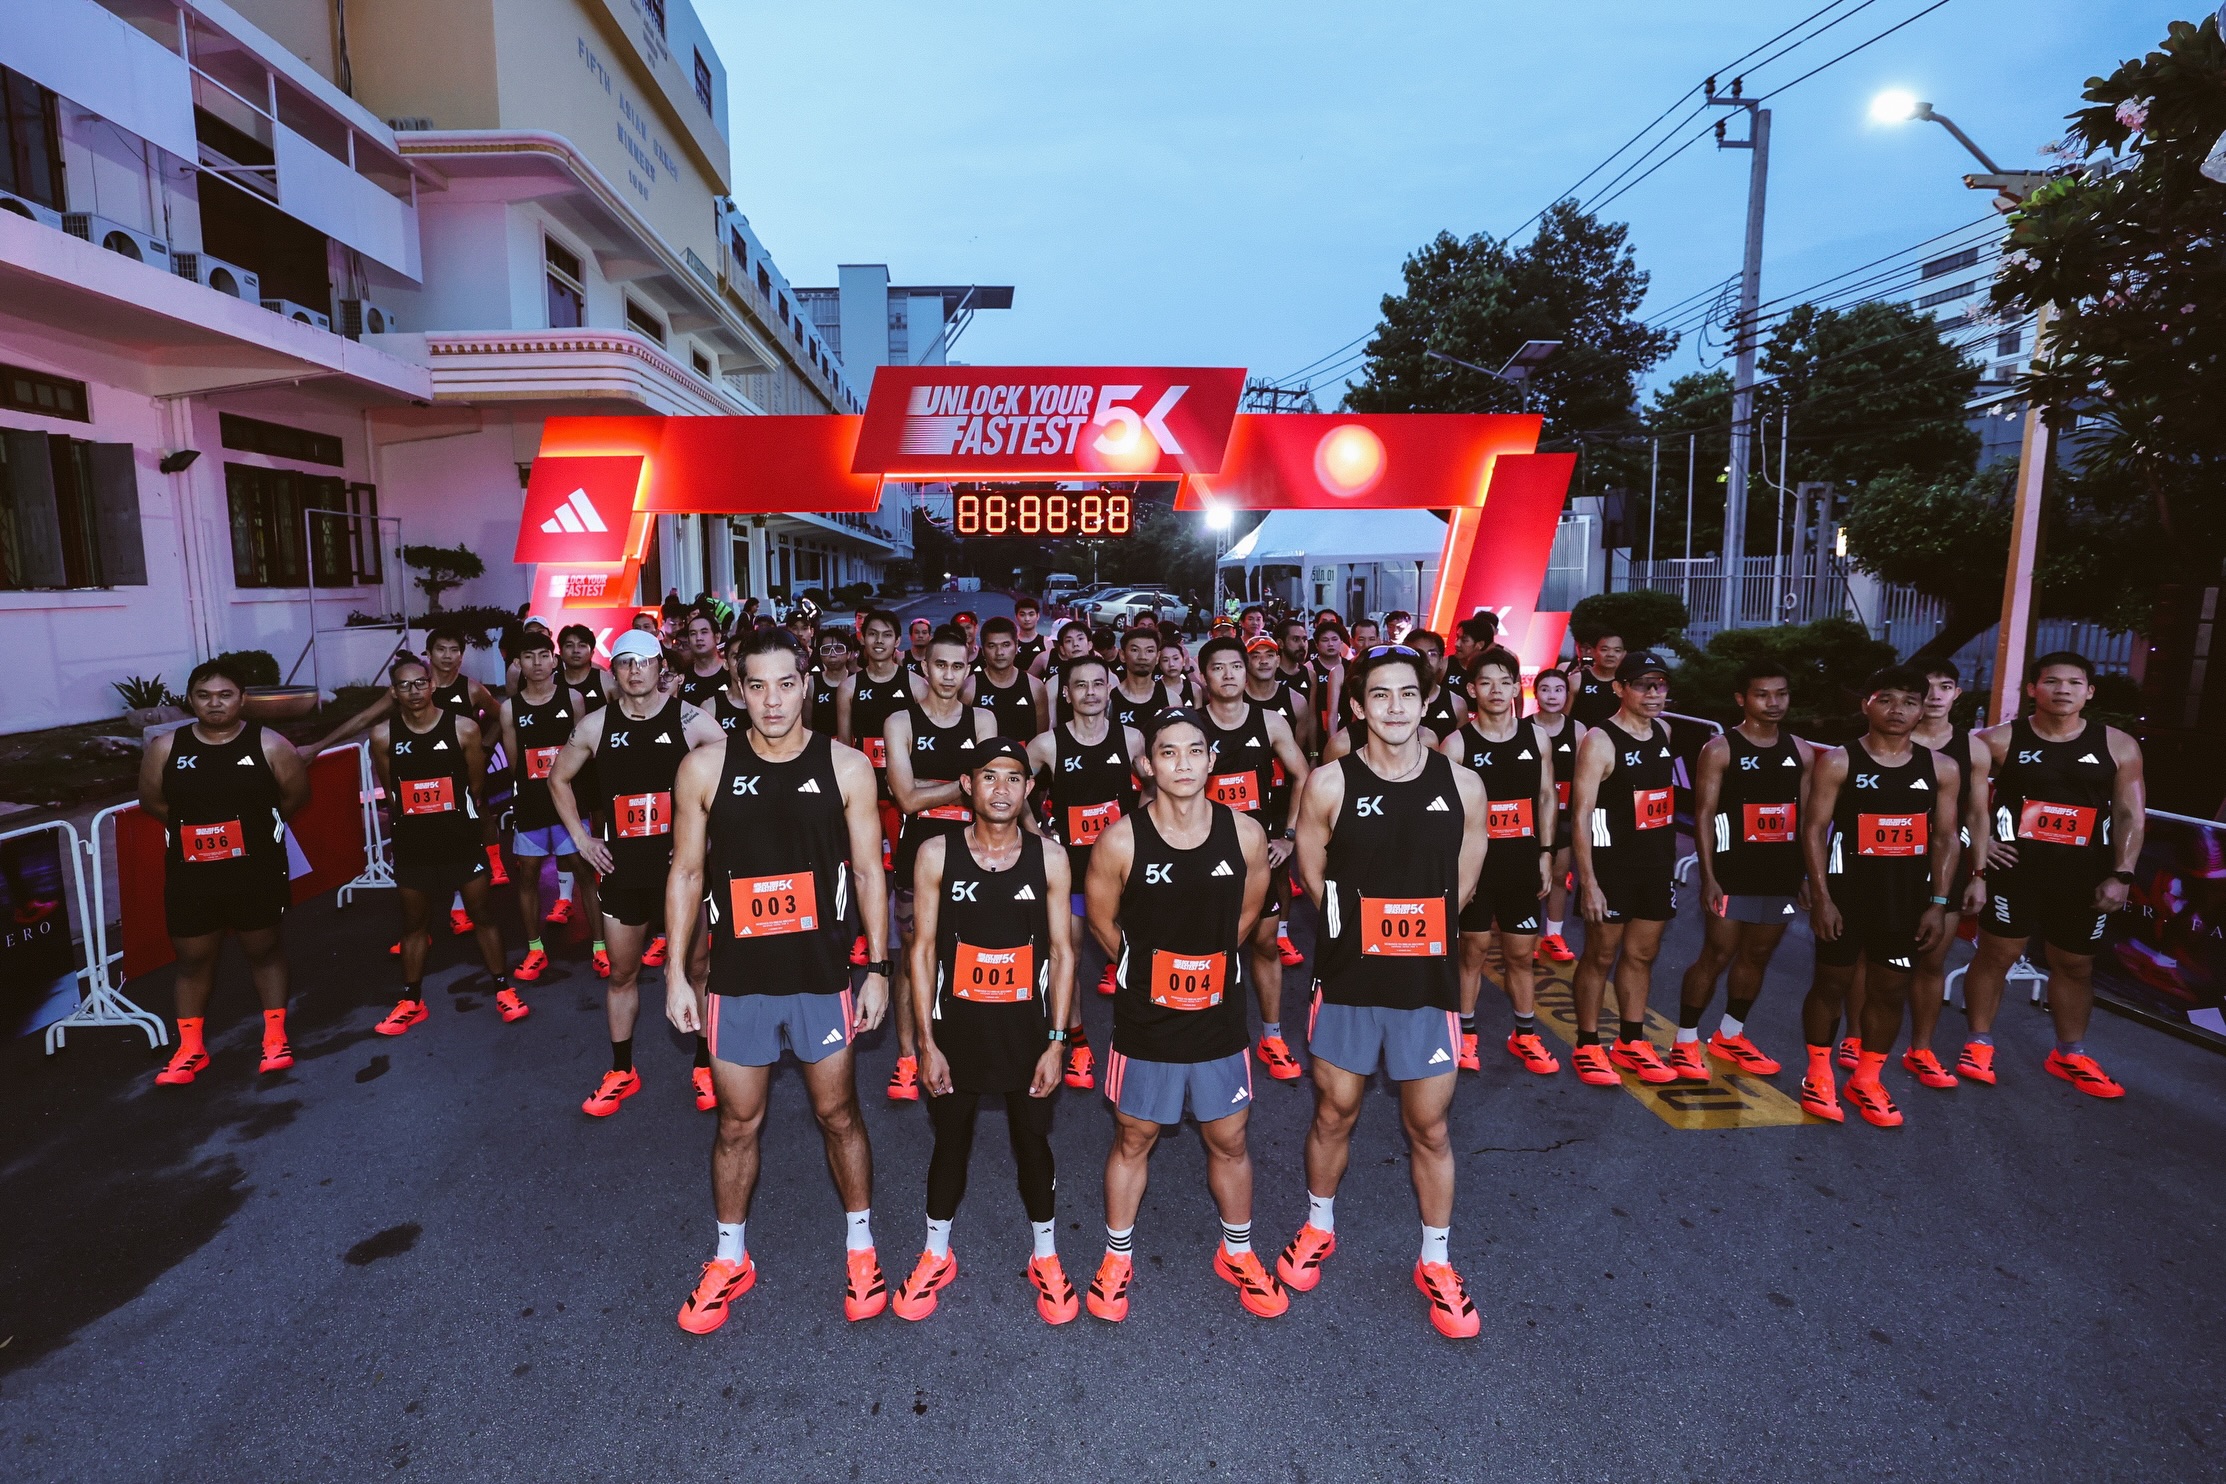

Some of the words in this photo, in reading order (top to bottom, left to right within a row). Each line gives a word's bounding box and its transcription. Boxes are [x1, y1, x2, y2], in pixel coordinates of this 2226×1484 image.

[577, 37, 612, 96] FIFTH
[619, 92, 647, 141] ASIAN
[918, 385, 1025, 416] UNLOCK
[1029, 385, 1093, 416] YOUR
[1092, 385, 1190, 455] 5K
[945, 416, 1088, 455] FASTEST
[1327, 569, 1335, 581] 01
[1472, 606, 1513, 636] K
[1448, 676, 1461, 684] 5K
[684, 683, 697, 693] 5K
[859, 689, 872, 700] 5K
[1585, 685, 1598, 694] 5K
[818, 693, 830, 703] 5K
[981, 695, 994, 705] 5K
[519, 714, 534, 727] 5K
[722, 717, 736, 729] 5K
[1119, 711, 1135, 723] 5K
[610, 731, 629, 747] 5K
[917, 737, 935, 750] 5K
[395, 741, 412, 754] 5K
[873, 748, 887, 758] 05
[1210, 740, 1220, 753] K
[176, 755, 198, 769] 5K
[537, 758, 553, 769] 02
[1064, 755, 1083, 772] 5K
[1474, 752, 1493, 767] 5K
[1625, 751, 1642, 766] 5K
[1740, 756, 1760, 770] 5K
[2018, 750, 2043, 764] 5K
[732, 775, 761, 796] 5K
[1855, 774, 1880, 789] 5K
[413, 790, 441, 803] 037
[1218, 786, 1247, 801] 039
[1356, 795, 1384, 817] 5K
[627, 807, 658, 824] 030
[1489, 813, 1520, 827] 074
[1757, 817, 1786, 830] 007
[2037, 815, 2078, 832] 043
[195, 835, 229, 850] 036
[1876, 829, 1913, 842] 075
[1145, 863, 1174, 884] 5K
[779, 879, 793, 891] 5K
[951, 881, 980, 902] 5K
[752, 895, 797, 917] 003
[1410, 904, 1425, 914] 5K
[1381, 919, 1426, 937] 002
[1002, 953, 1016, 963] 5K
[1197, 959, 1211, 970] 5K
[972, 967, 1014, 985] 001
[1169, 973, 1210, 993] 004
